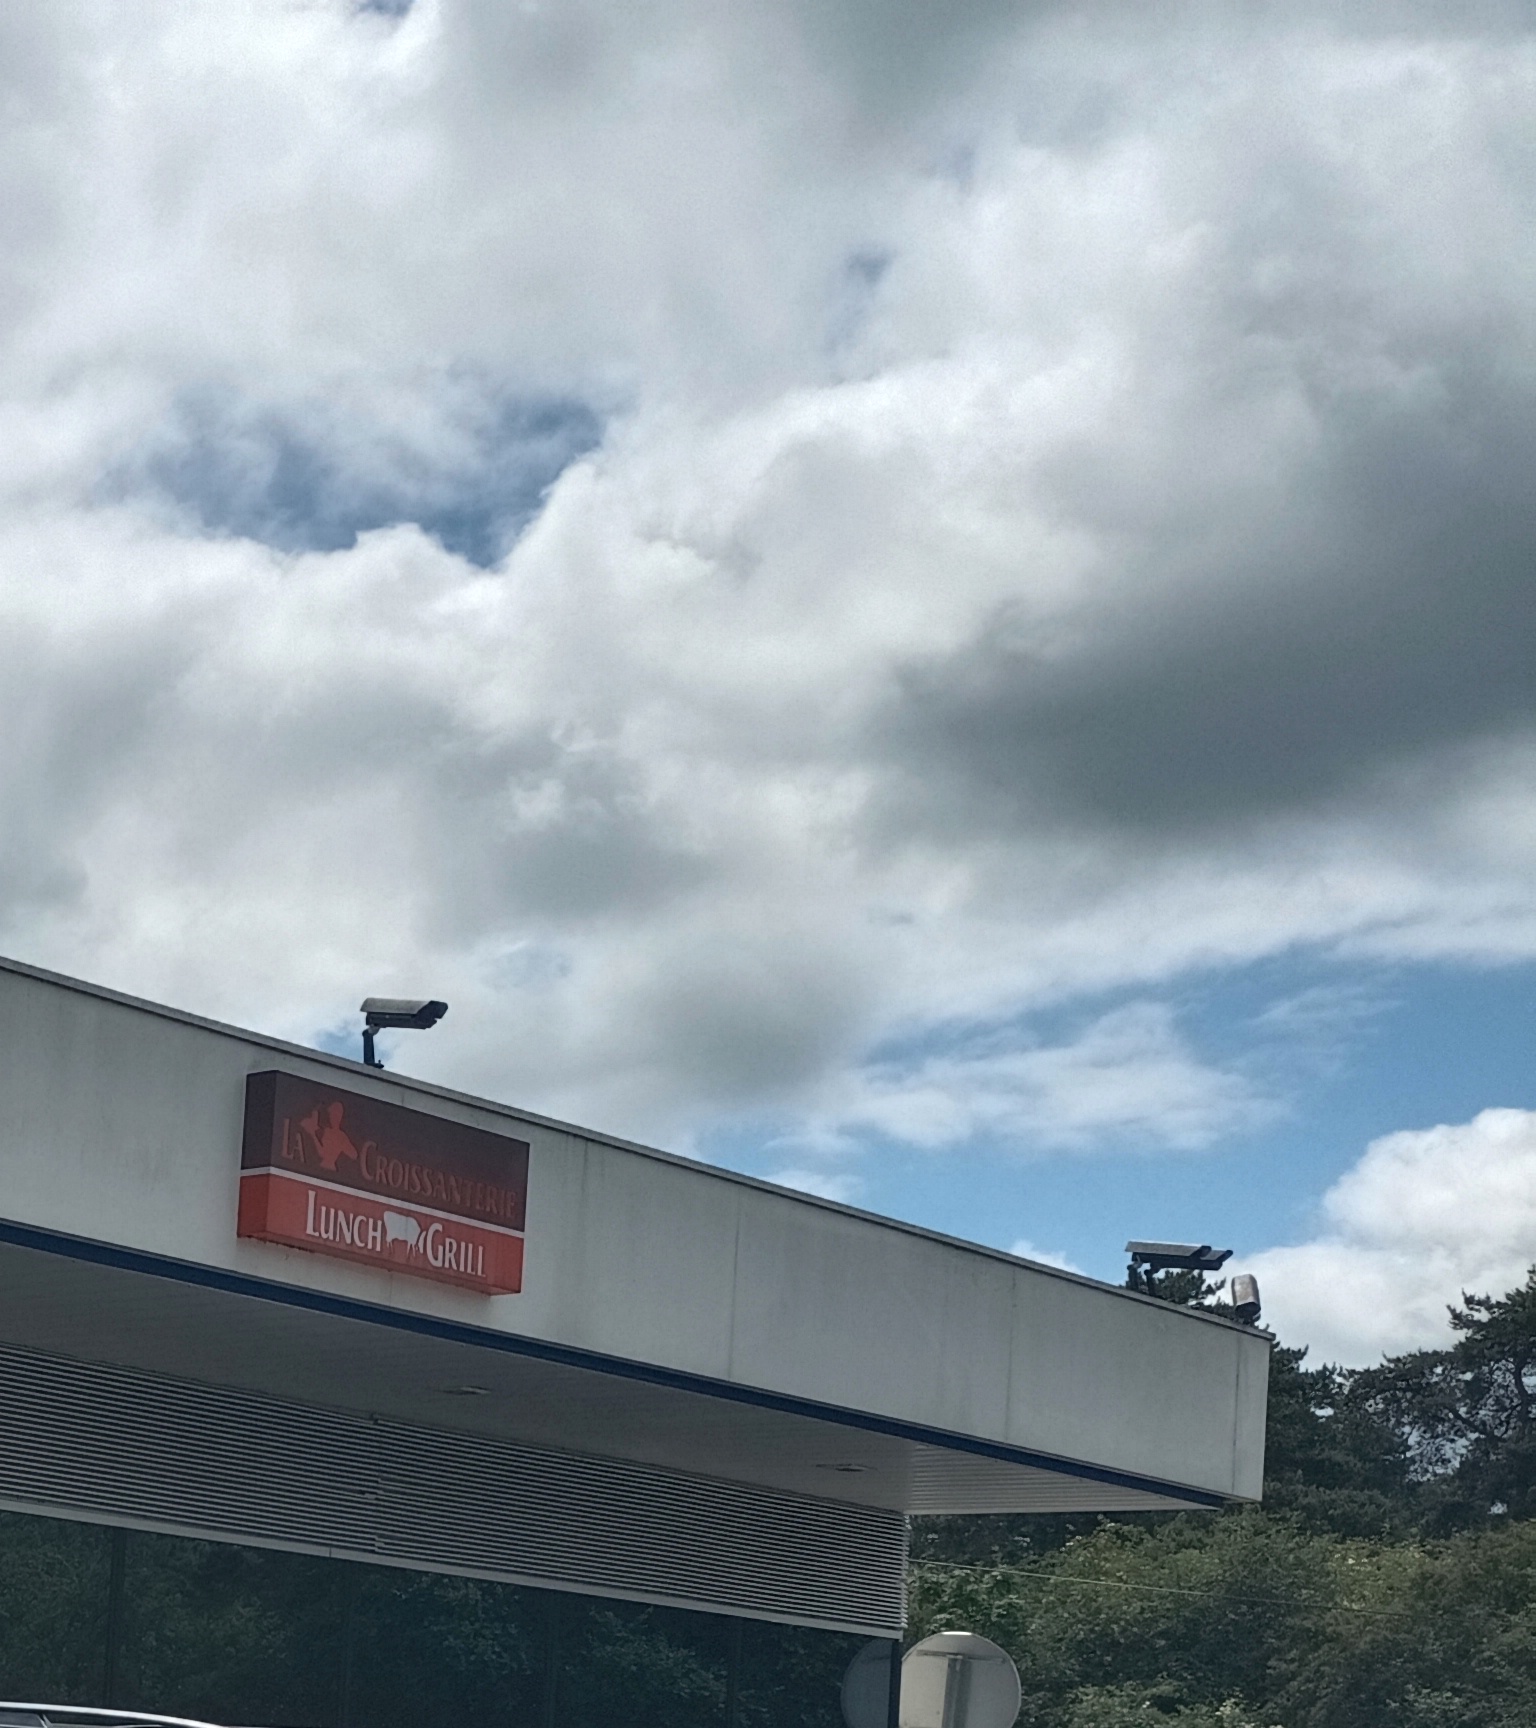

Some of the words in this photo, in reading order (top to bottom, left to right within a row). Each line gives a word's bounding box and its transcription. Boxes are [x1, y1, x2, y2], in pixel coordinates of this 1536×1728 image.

[360, 1140, 517, 1218] CROISSANTERIE
[305, 1190, 381, 1252] LUNCH
[427, 1223, 486, 1278] GRILL
